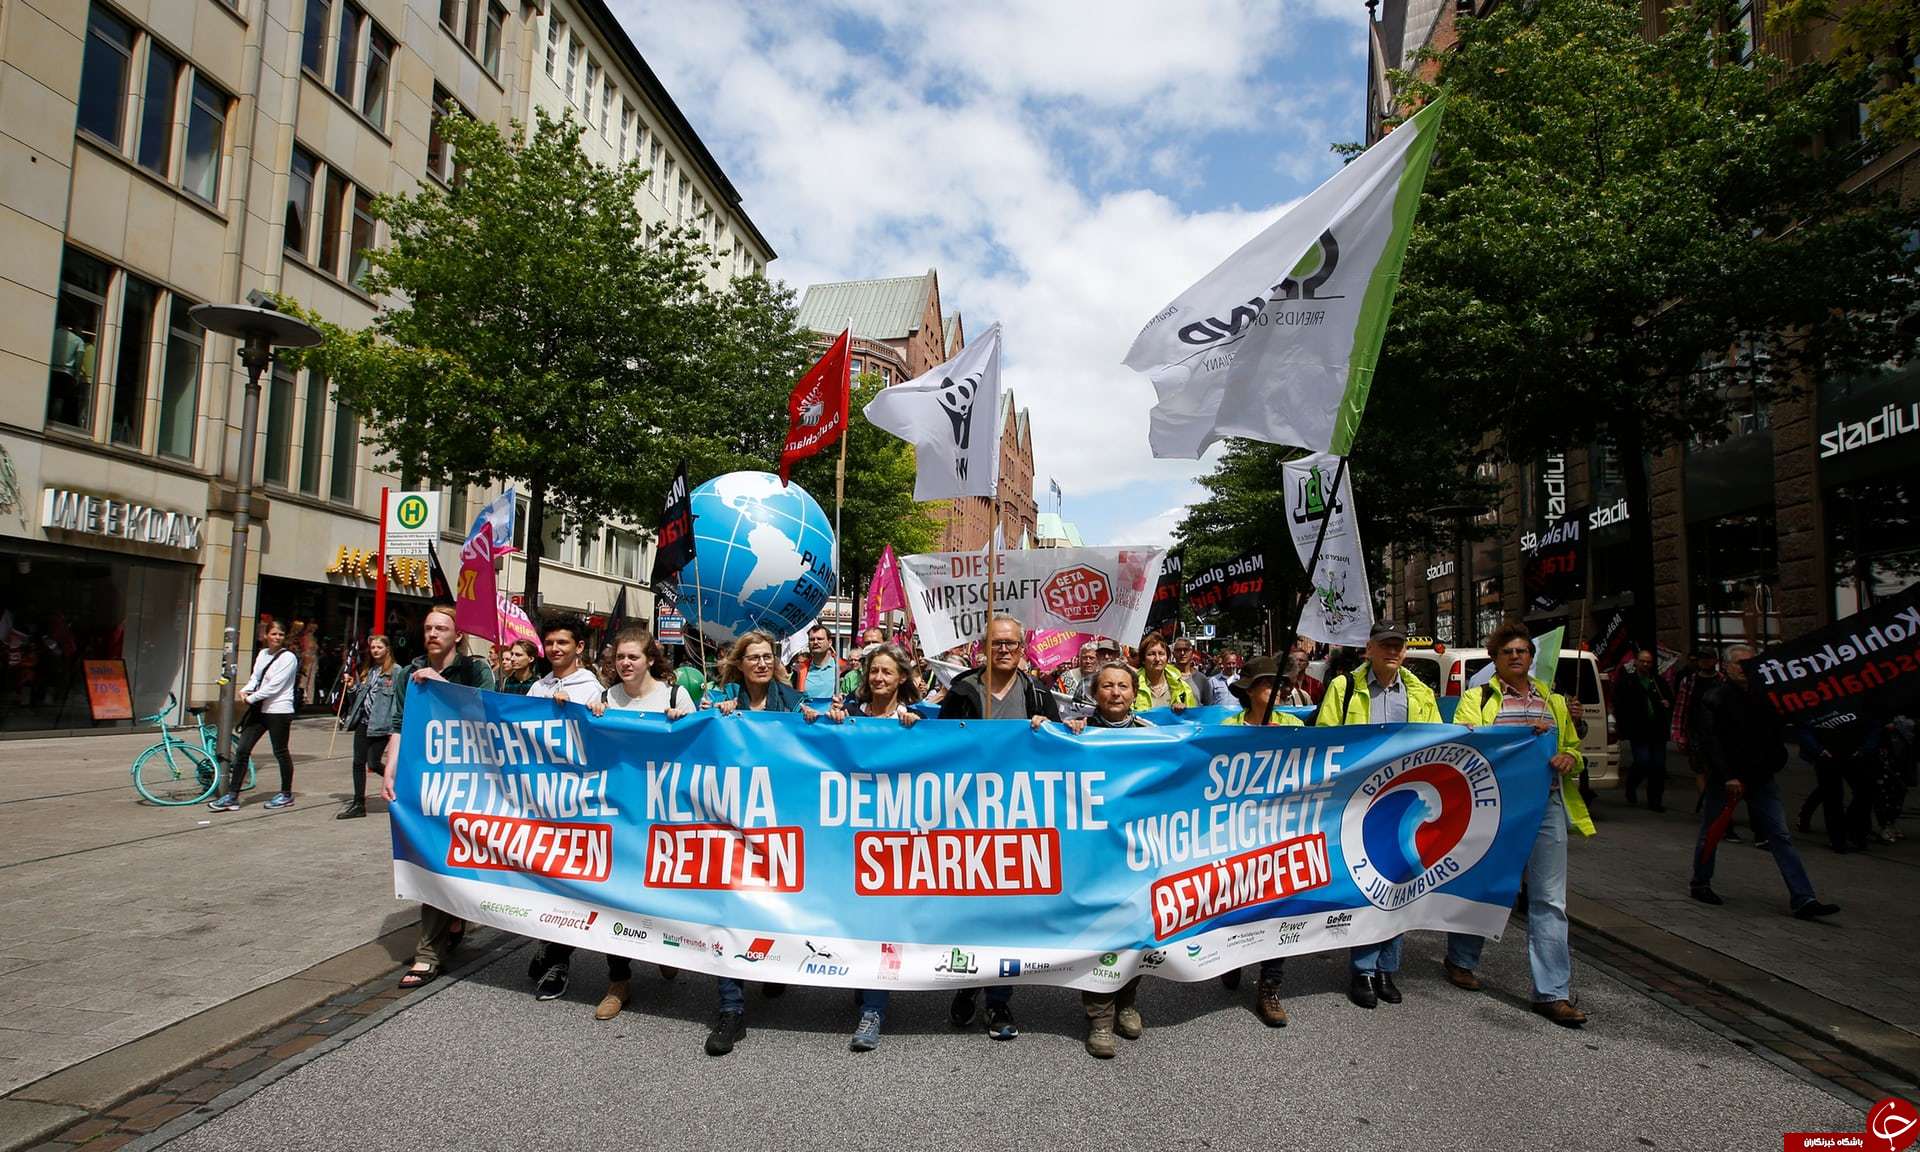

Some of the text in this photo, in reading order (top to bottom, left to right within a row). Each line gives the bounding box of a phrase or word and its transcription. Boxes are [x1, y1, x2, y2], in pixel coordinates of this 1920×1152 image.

[1820, 403, 1920, 459] stadiu
[42, 488, 202, 550] WEEKDAY
[951, 554, 1006, 579] DIESE
[1426, 560, 1455, 581] stadium
[920, 579, 1041, 615] WIRTSCHAFT
[1049, 580, 1103, 608] STOP
[1063, 605, 1100, 617] TTIP
[425, 719, 588, 766] GERECHTEN
[1204, 745, 1345, 801] SOZIALE
[1362, 766, 1395, 797] G20
[420, 770, 619, 819] WELTHANDEL
[646, 761, 779, 829] KLIMA
[819, 771, 1108, 831] DEMOKRATIE
[453, 817, 608, 878] SCHAFFEN
[649, 829, 797, 888] RETTEN
[860, 827, 1052, 890] STÄRKEN
[1155, 838, 1328, 936] BEKÄMPFEN
[1353, 857, 1460, 907] 2. JULI HAMBURG
[480, 900, 533, 918] GREENPEACE
[540, 911, 598, 931] campact!
[623, 927, 648, 939] BUND
[1278, 932, 1301, 946] Shift
[1279, 920, 1307, 933] Power
[747, 951, 764, 960] DGB
[806, 963, 850, 976] NABU
[1093, 967, 1121, 980] OXFAM
